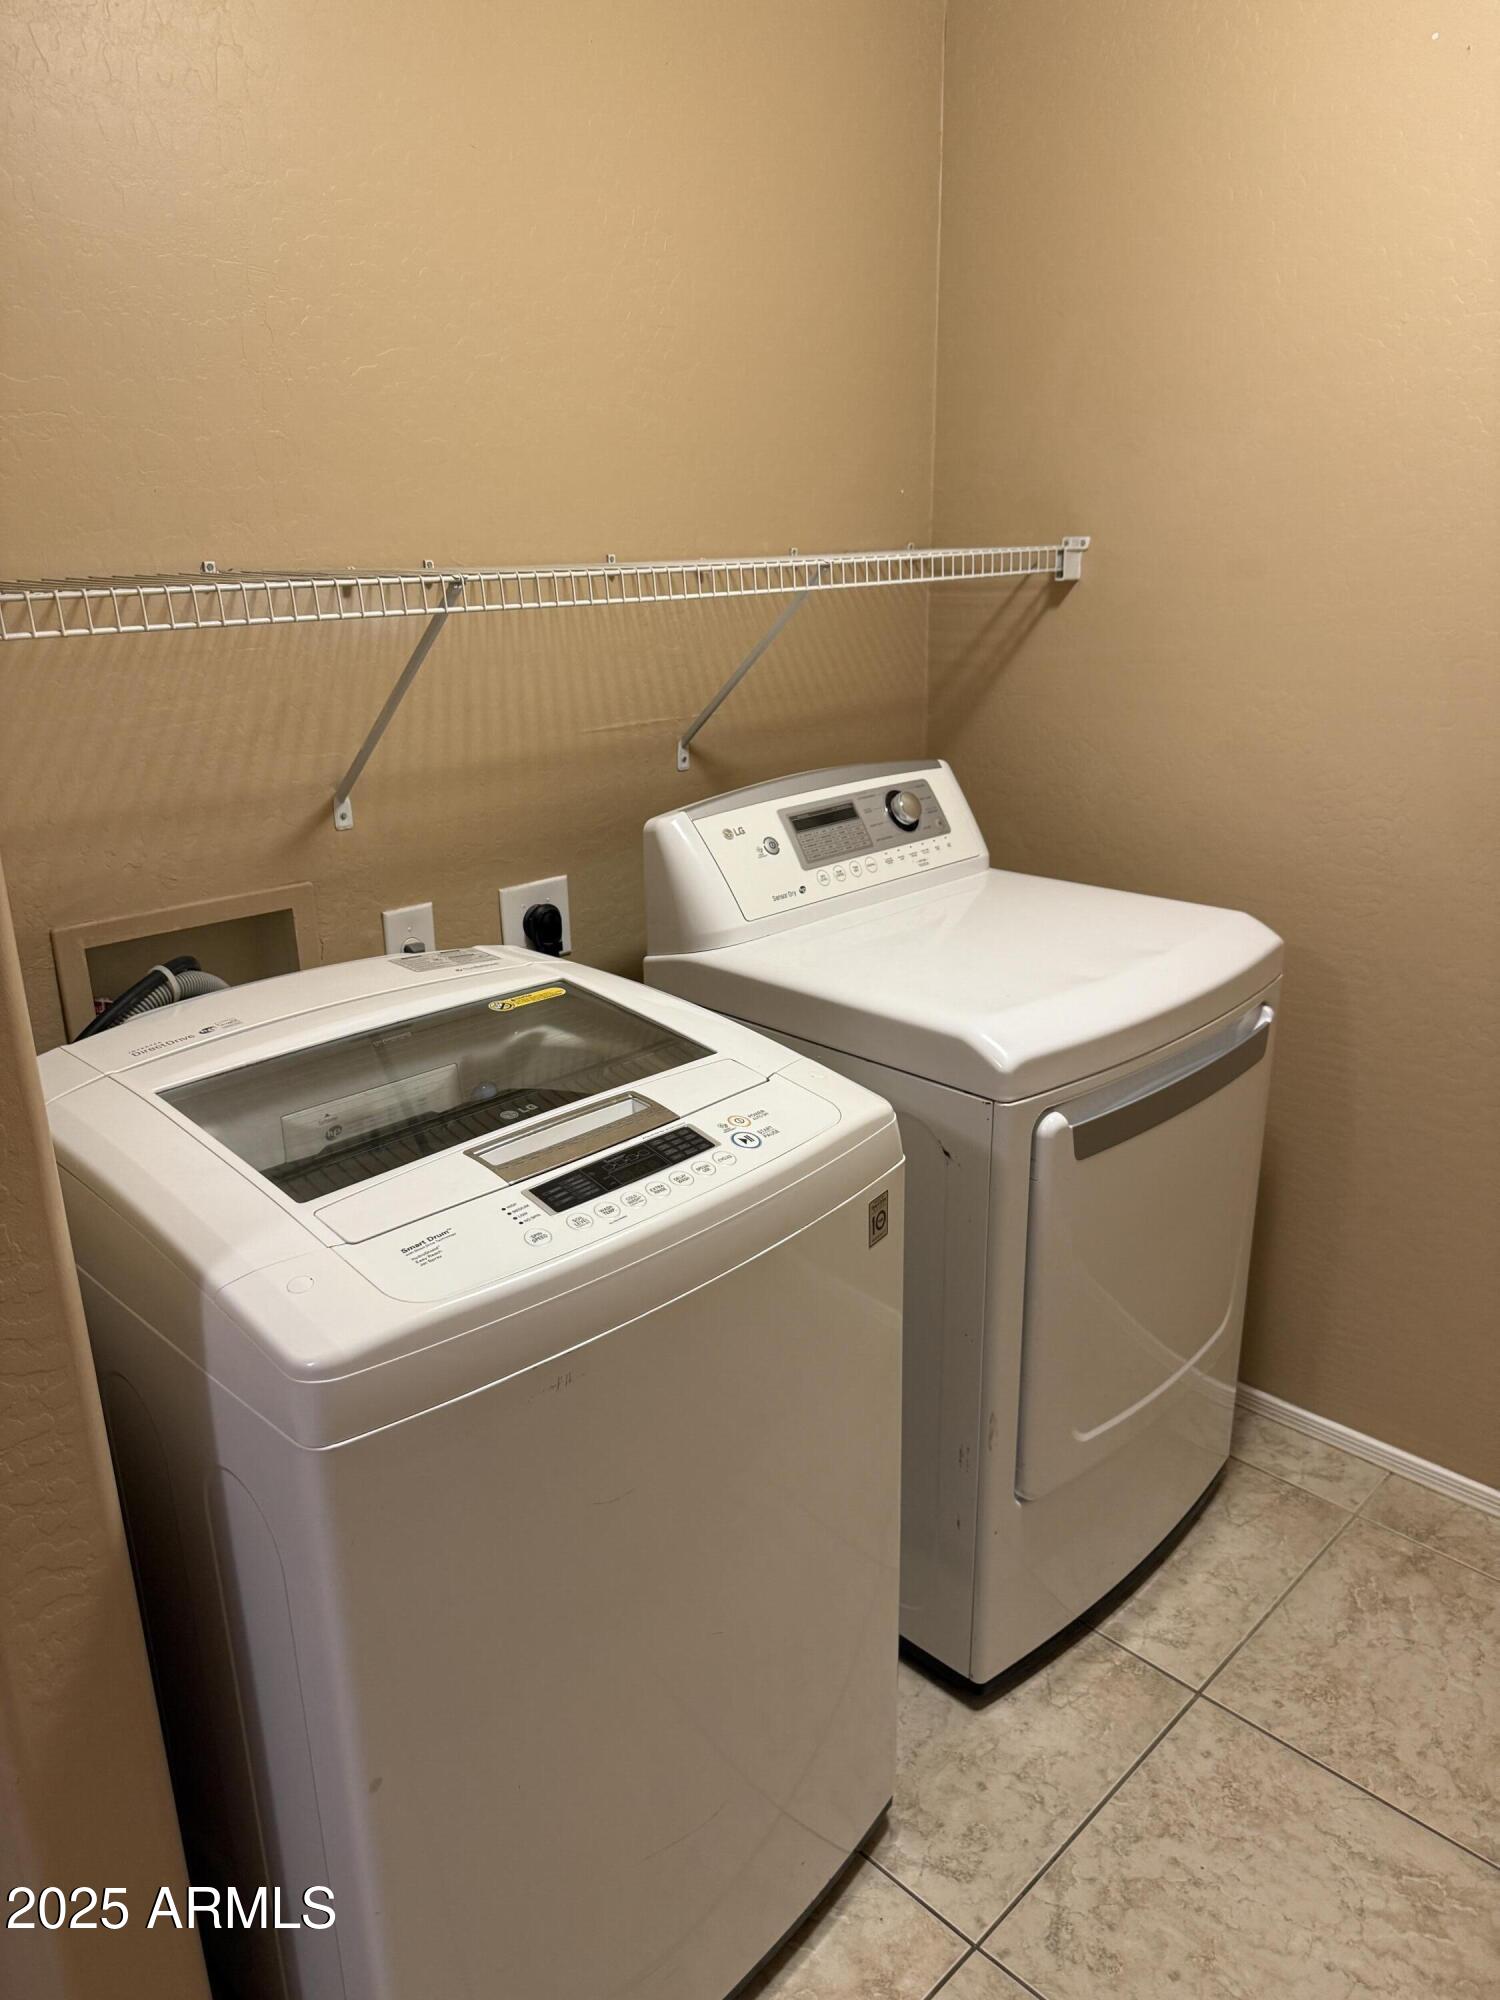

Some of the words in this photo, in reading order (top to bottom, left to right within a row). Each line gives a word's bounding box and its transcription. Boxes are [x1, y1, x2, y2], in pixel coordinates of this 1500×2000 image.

[733, 826, 746, 837] LG
[772, 892, 788, 901] Sensor
[787, 890, 797, 898] Dry
[517, 1103, 539, 1114] LG
[400, 1240, 426, 1254] Smart
